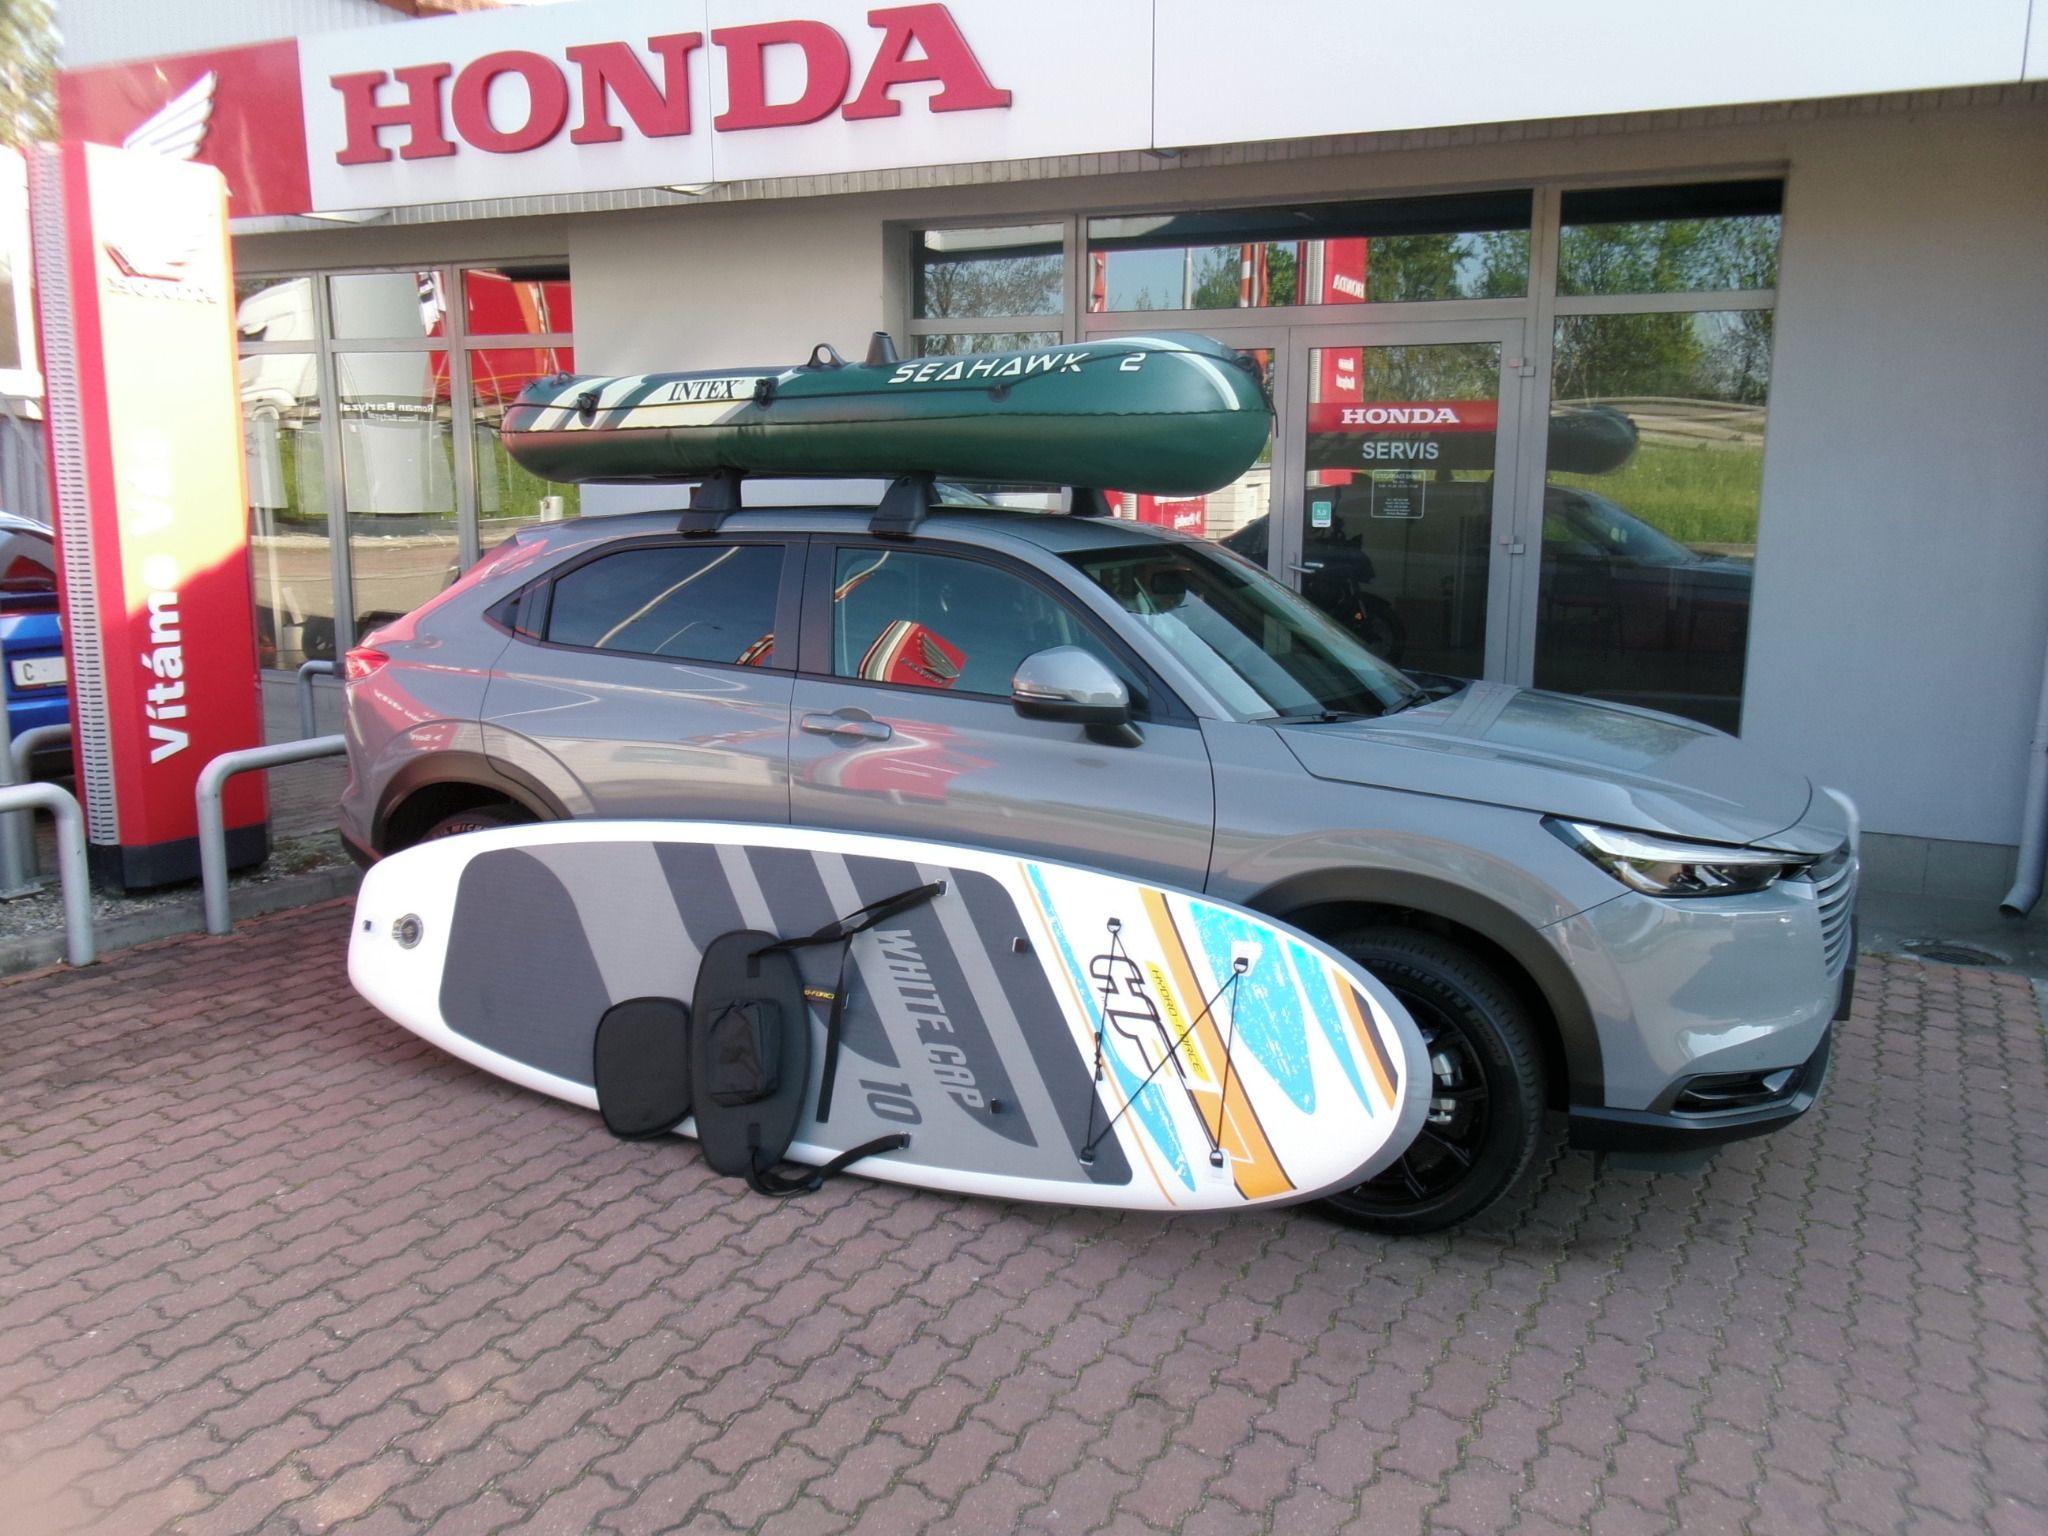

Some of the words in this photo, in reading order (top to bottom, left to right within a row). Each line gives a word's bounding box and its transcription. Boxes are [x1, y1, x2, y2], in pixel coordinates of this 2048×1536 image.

[329, 3, 1012, 166] HONDA
[888, 352, 1090, 384] SEAHAWK
[1119, 352, 1146, 372] 2
[667, 380, 741, 401] INTEX
[1341, 408, 1460, 424] HONDA
[1362, 442, 1439, 460] SERVIS
[872, 929, 954, 1034] WHITE
[922, 1042, 985, 1108] CAP
[858, 1078, 923, 1125] 10
